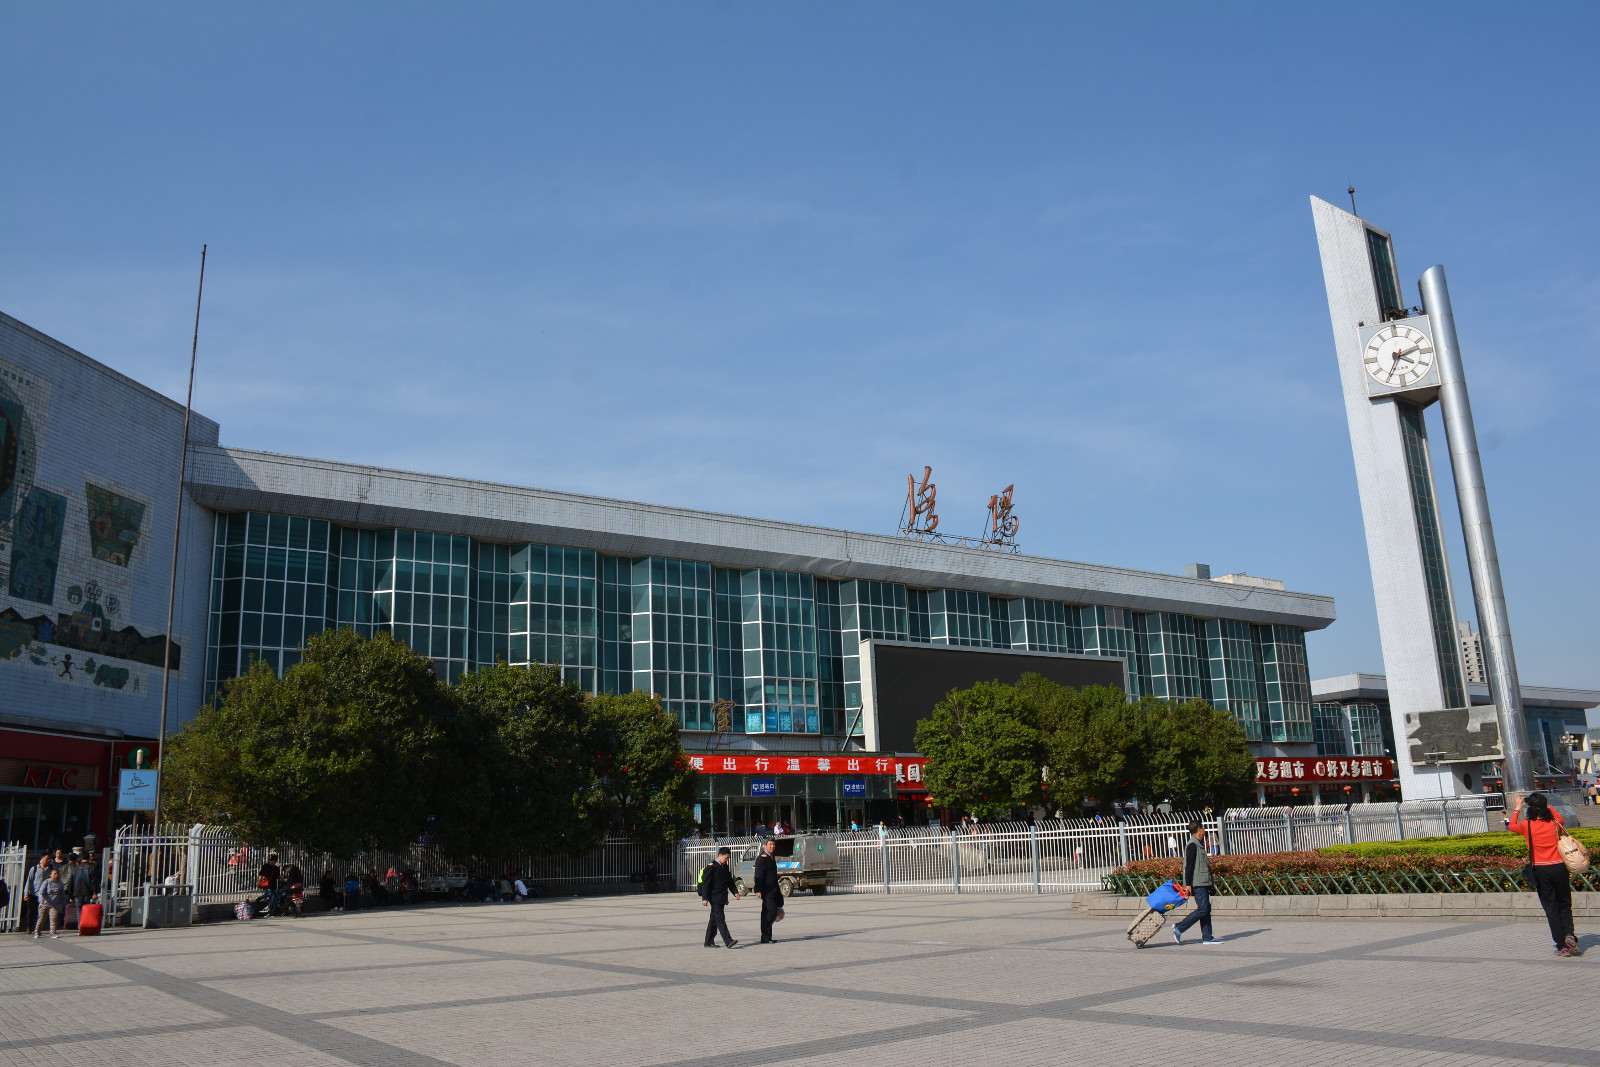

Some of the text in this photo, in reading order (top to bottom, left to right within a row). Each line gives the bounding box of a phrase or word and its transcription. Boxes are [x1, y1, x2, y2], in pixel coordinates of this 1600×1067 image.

[21, 765, 81, 790] KFC
[895, 762, 926, 784] 美国
[1326, 760, 1384, 779] 好又多超市
